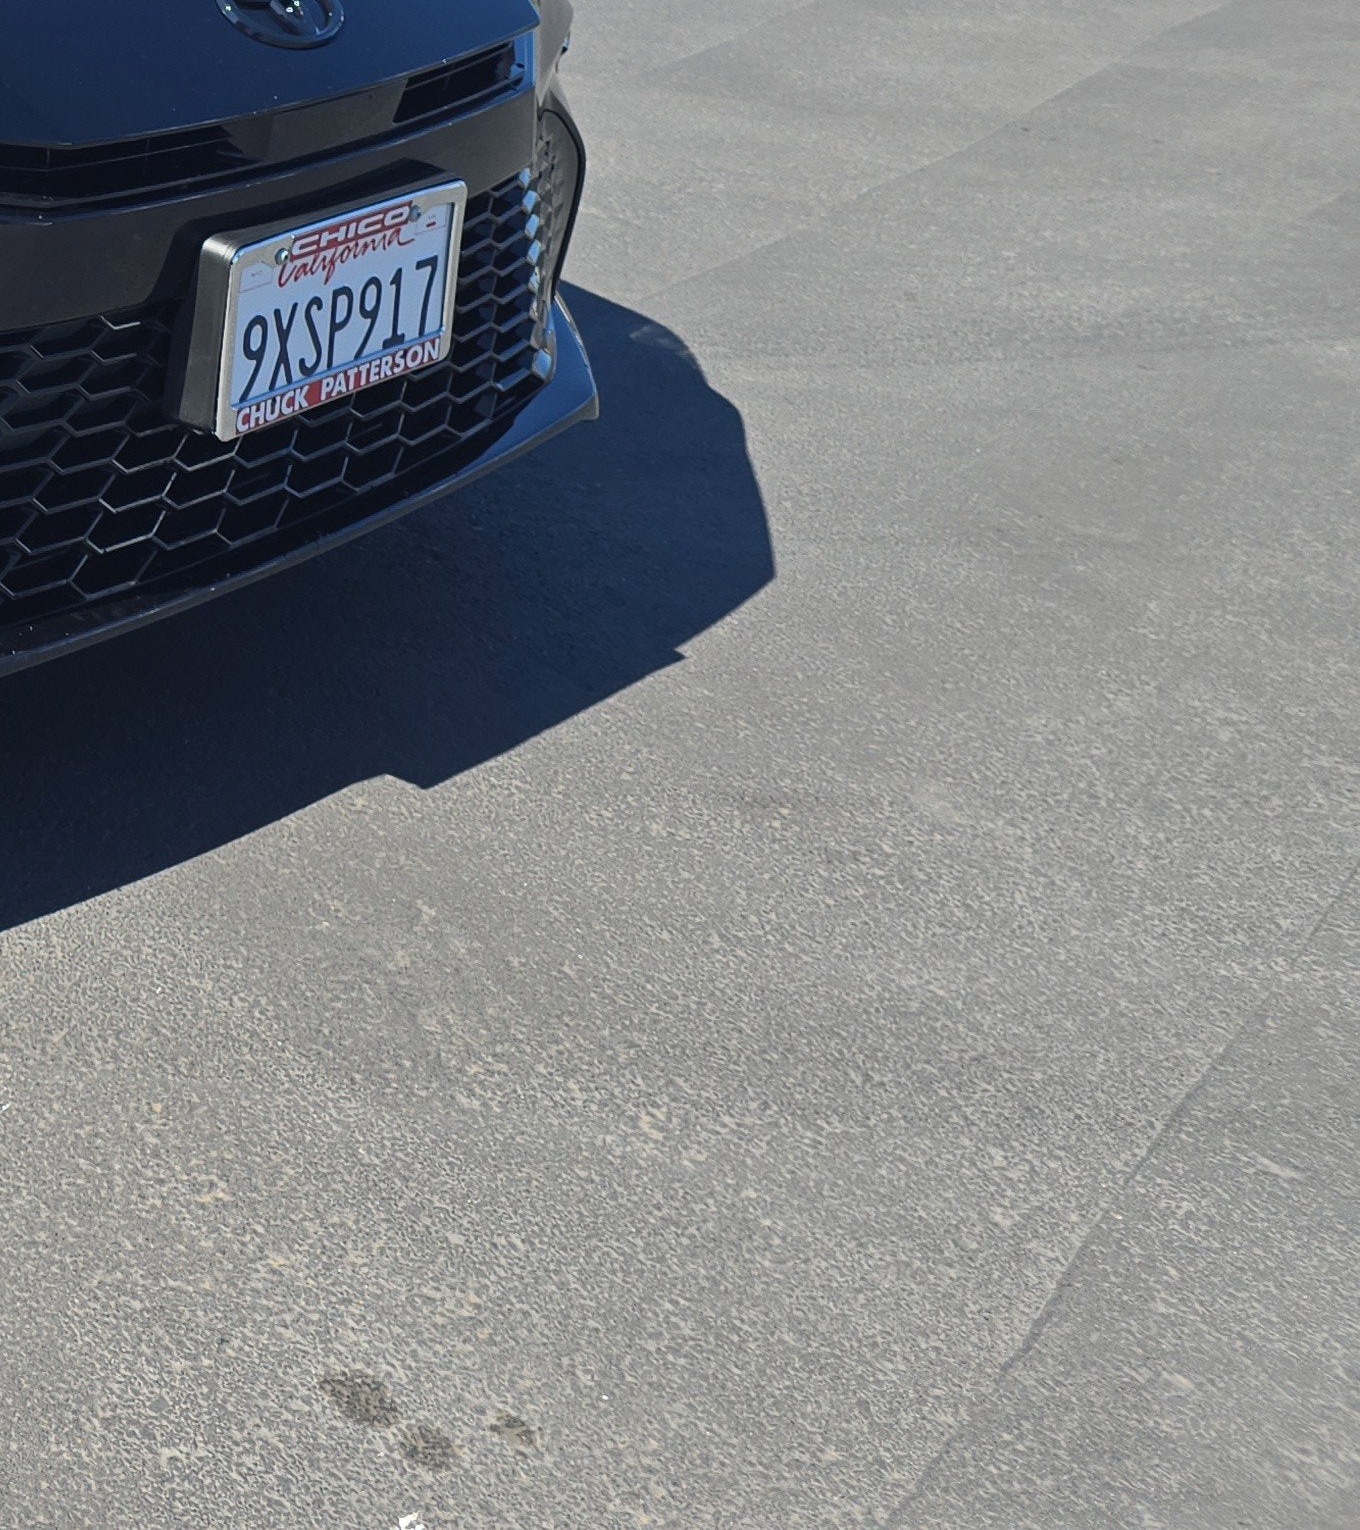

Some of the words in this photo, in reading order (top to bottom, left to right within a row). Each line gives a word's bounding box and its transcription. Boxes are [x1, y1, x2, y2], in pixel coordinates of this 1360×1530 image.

[277, 227, 415, 288] California
[291, 206, 410, 256] CHICO
[238, 254, 439, 403] 9XSP917
[236, 384, 310, 433] CHUCK
[320, 336, 440, 401] PATTERSON
